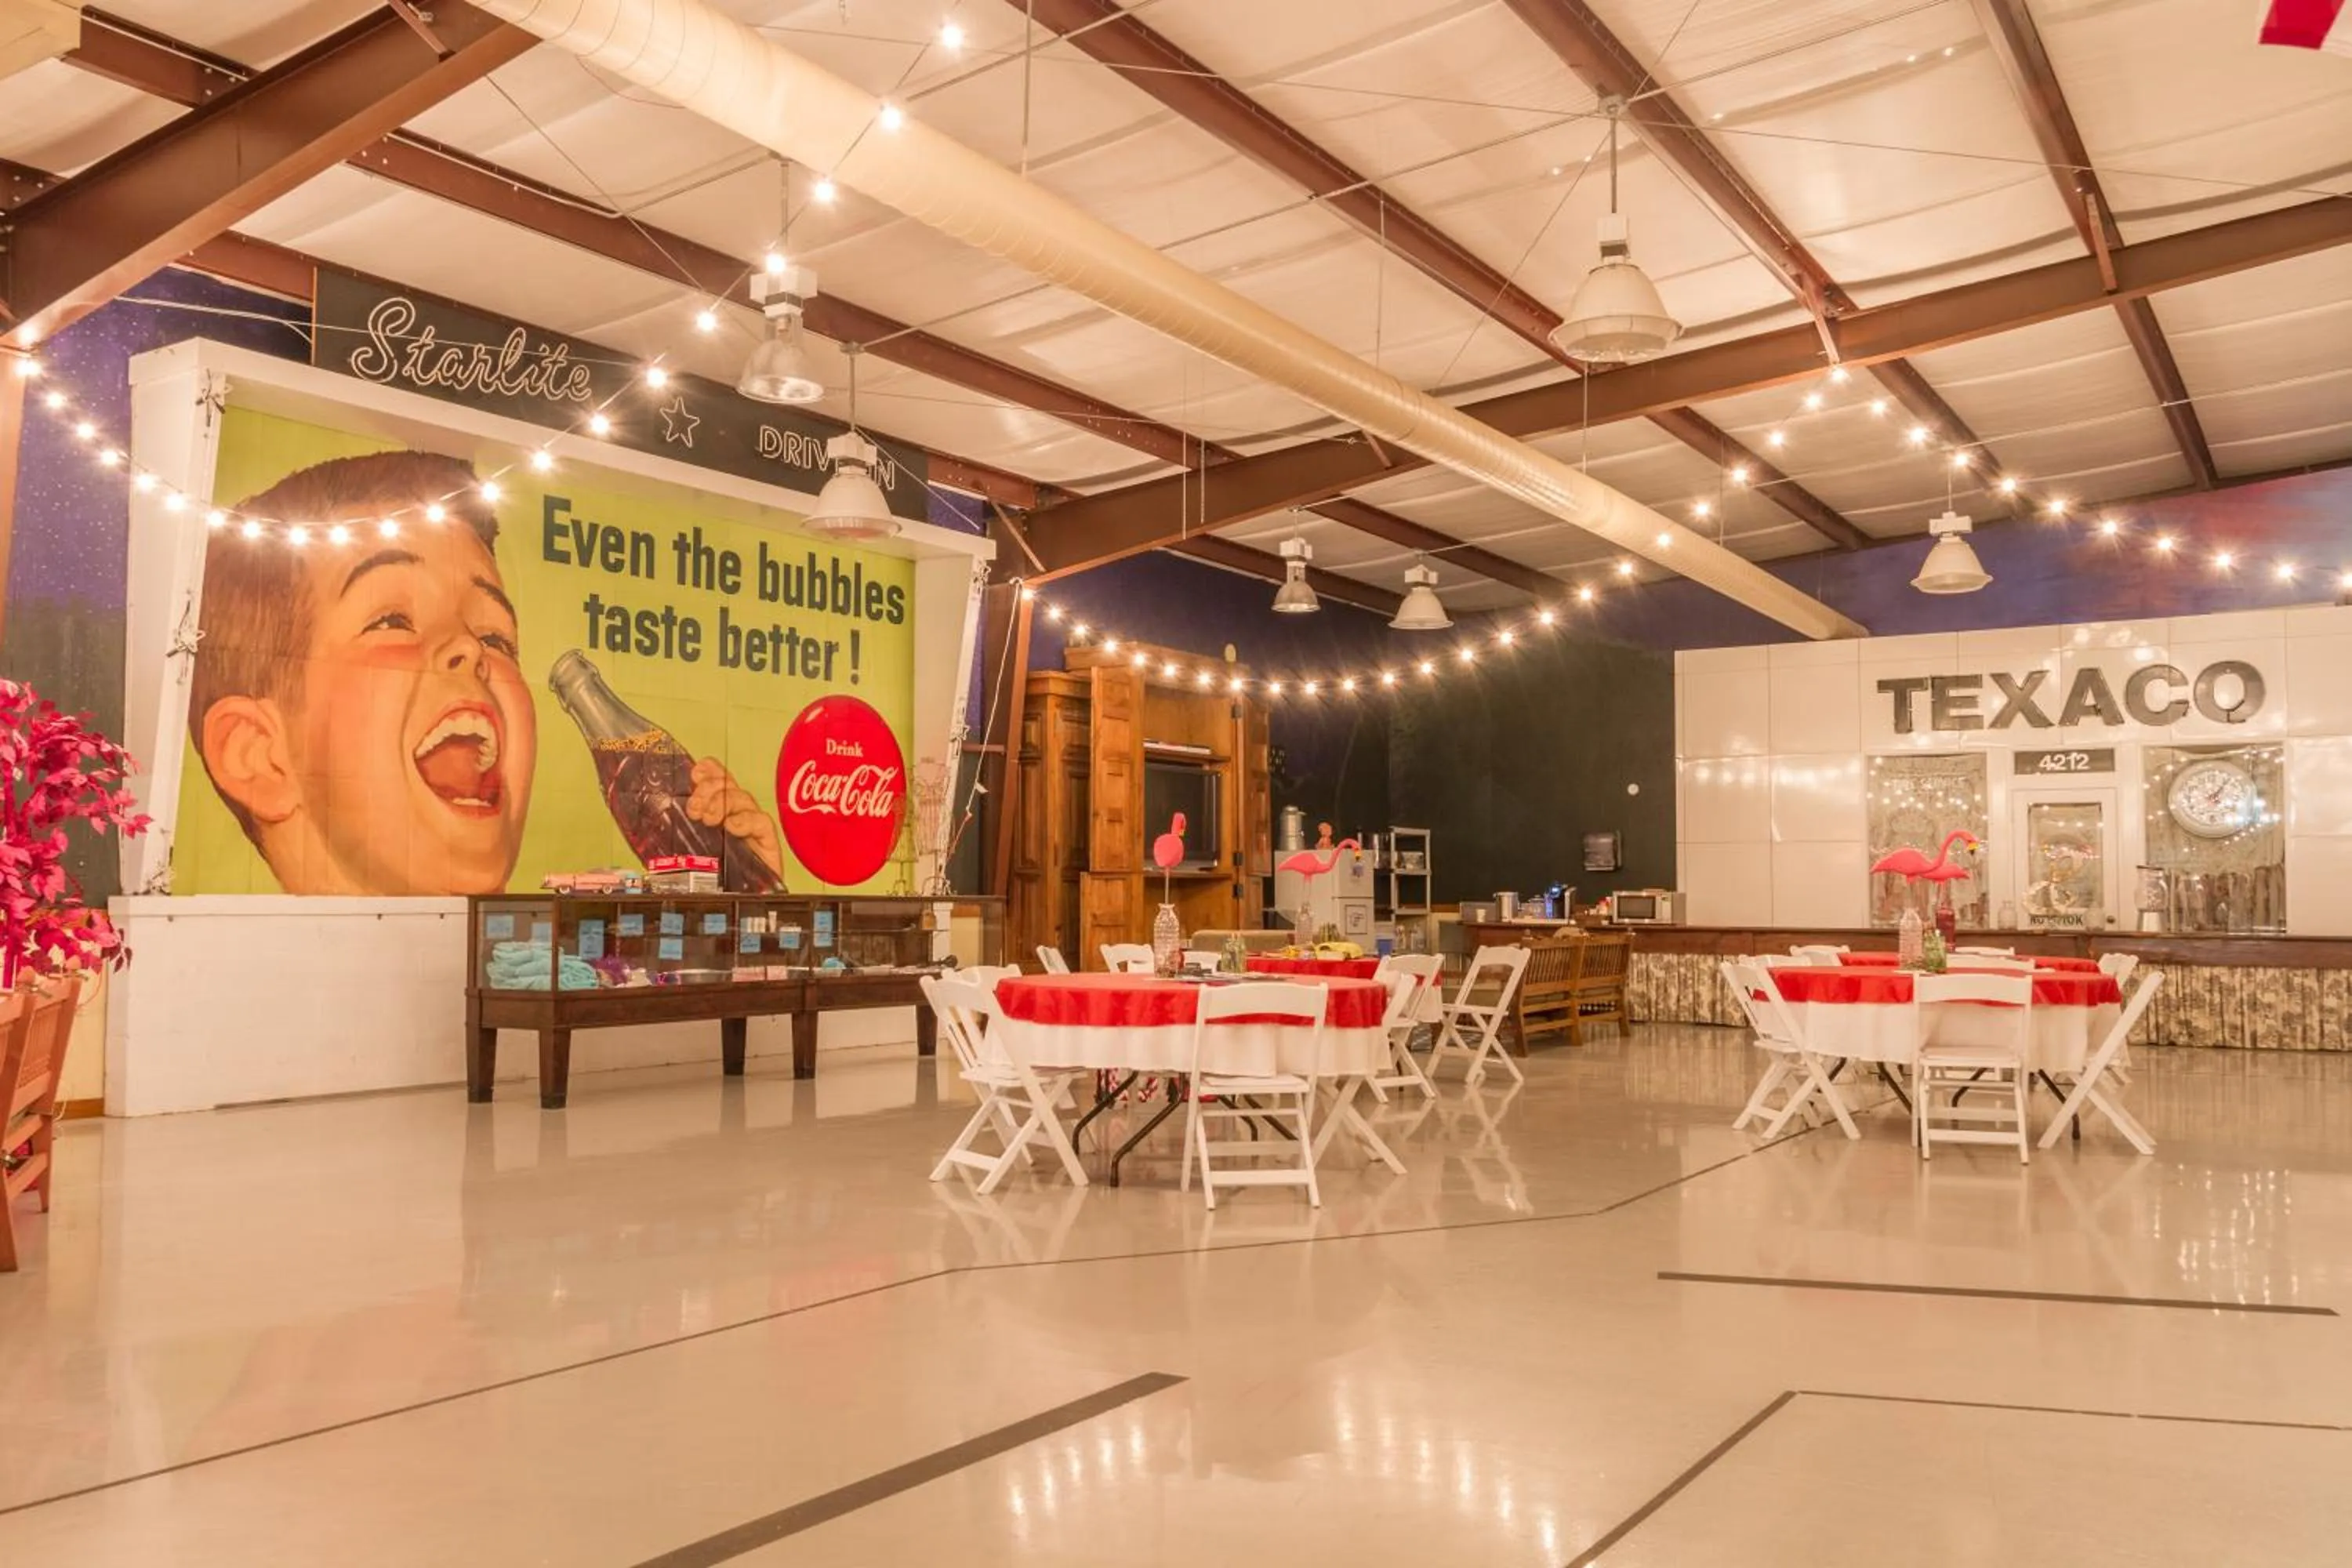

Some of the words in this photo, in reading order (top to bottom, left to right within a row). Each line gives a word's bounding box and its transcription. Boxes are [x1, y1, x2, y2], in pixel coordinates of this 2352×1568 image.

[350, 296, 592, 401] Starlite
[542, 494, 655, 579] Even
[672, 526, 742, 594] the
[758, 541, 906, 624] bubbles
[583, 592, 702, 662] taste
[1876, 659, 2267, 734] TEXACO
[826, 738, 864, 757] Drink
[2038, 753, 2091, 771] 4212
[787, 760, 898, 818] Coca-Cola
